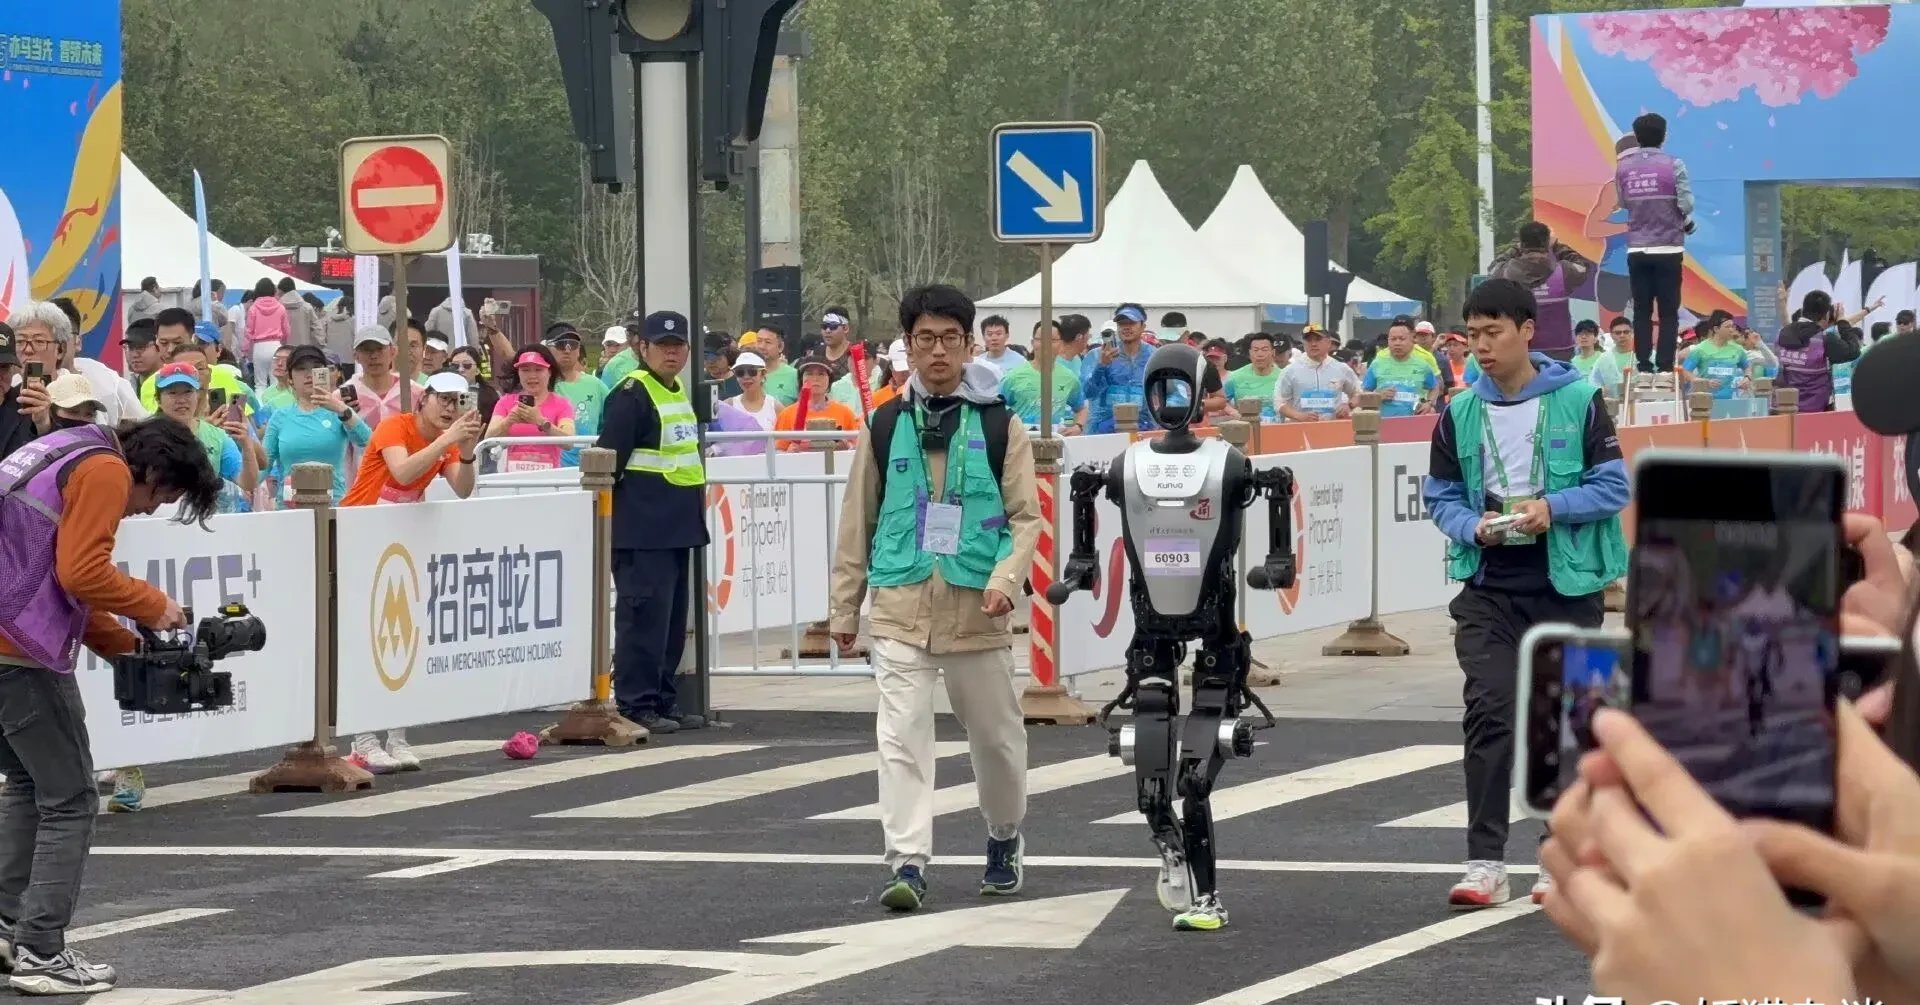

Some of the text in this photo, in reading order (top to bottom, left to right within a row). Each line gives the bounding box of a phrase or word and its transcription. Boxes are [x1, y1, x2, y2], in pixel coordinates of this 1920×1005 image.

[1155, 553, 1190, 563] 60903
[427, 544, 563, 645] 招商蛇口
[427, 641, 562, 674] CHINA MERCHANTS SHEKOU HOLDINGS
